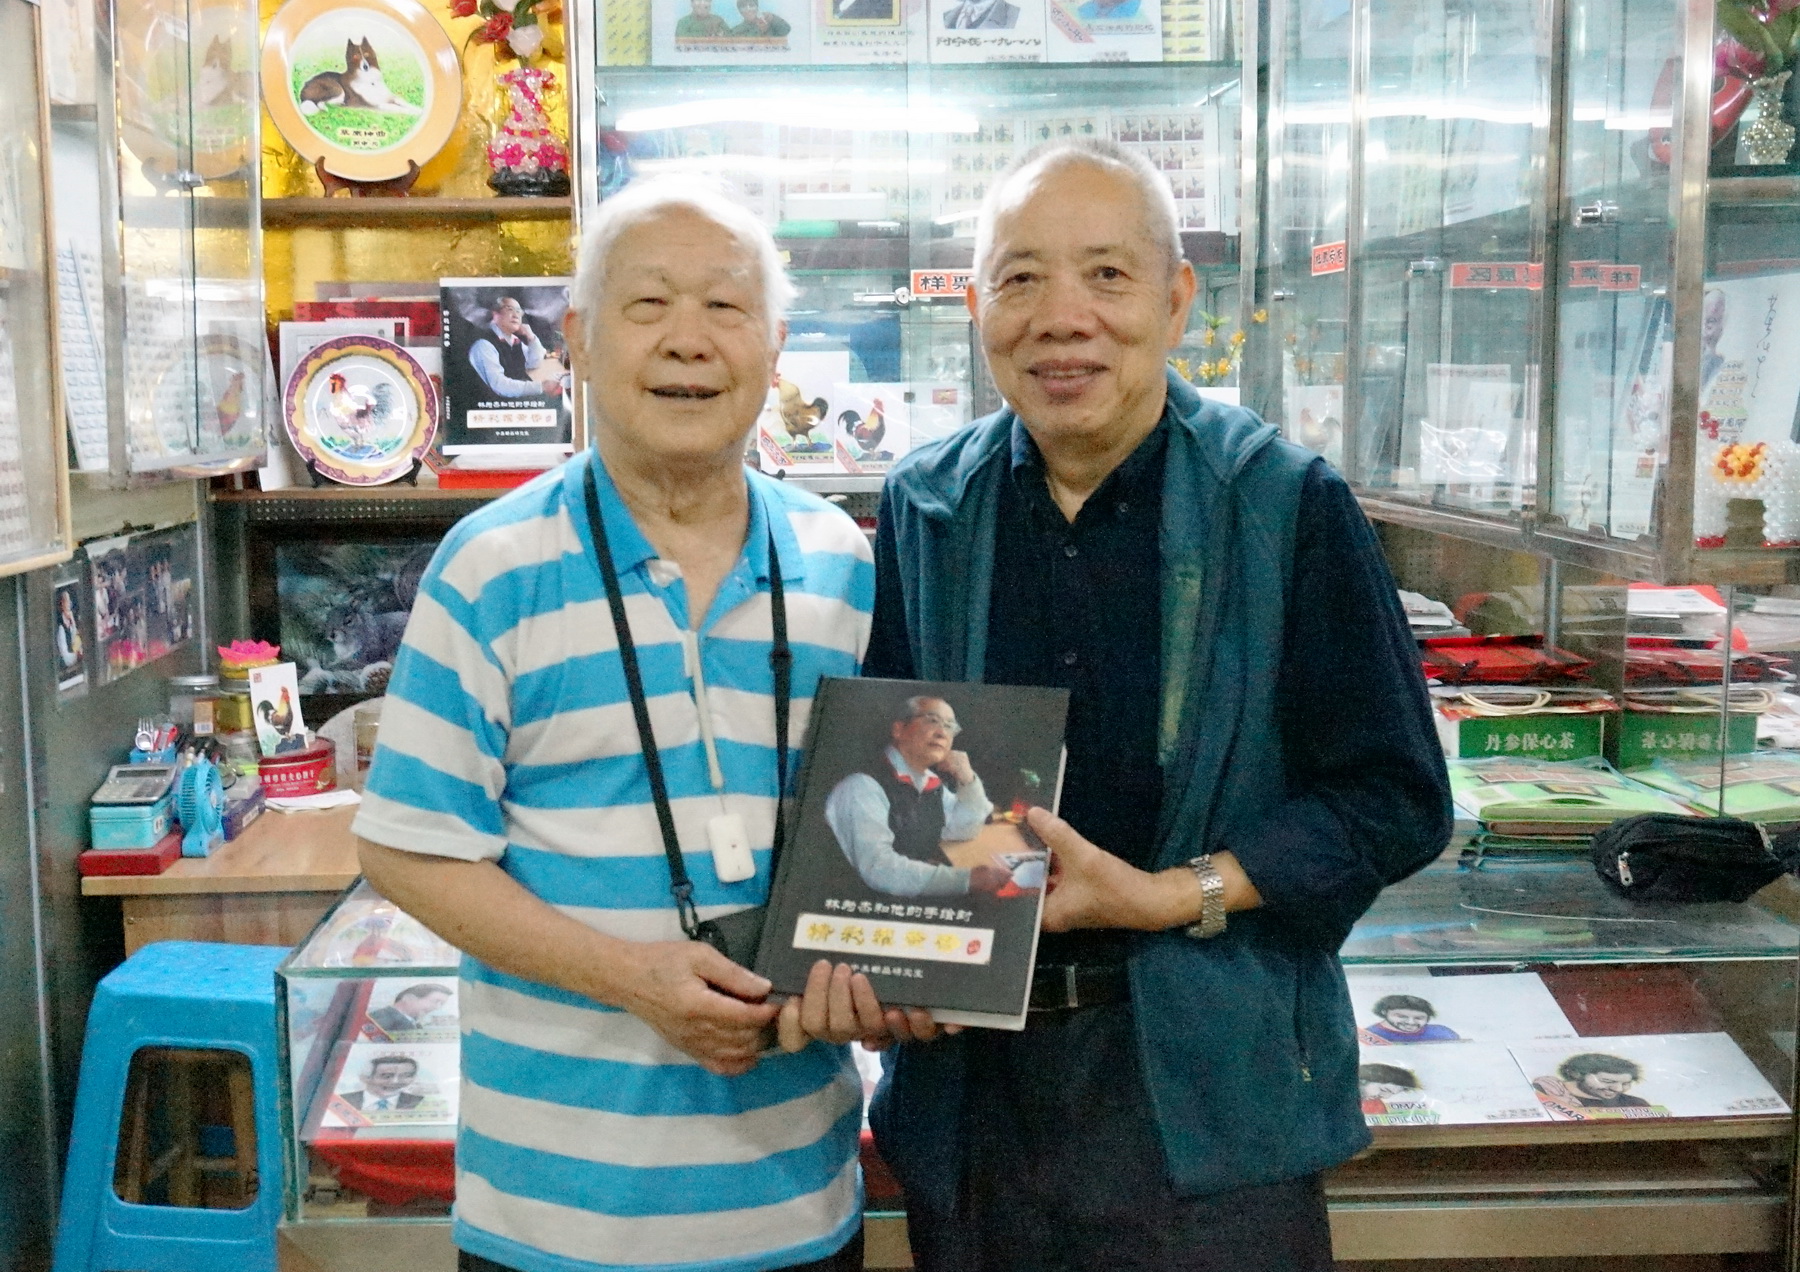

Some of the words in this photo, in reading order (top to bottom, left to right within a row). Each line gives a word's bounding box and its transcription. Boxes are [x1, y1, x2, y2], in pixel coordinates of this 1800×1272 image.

[1485, 732, 1575, 752] 丹参保心茶
